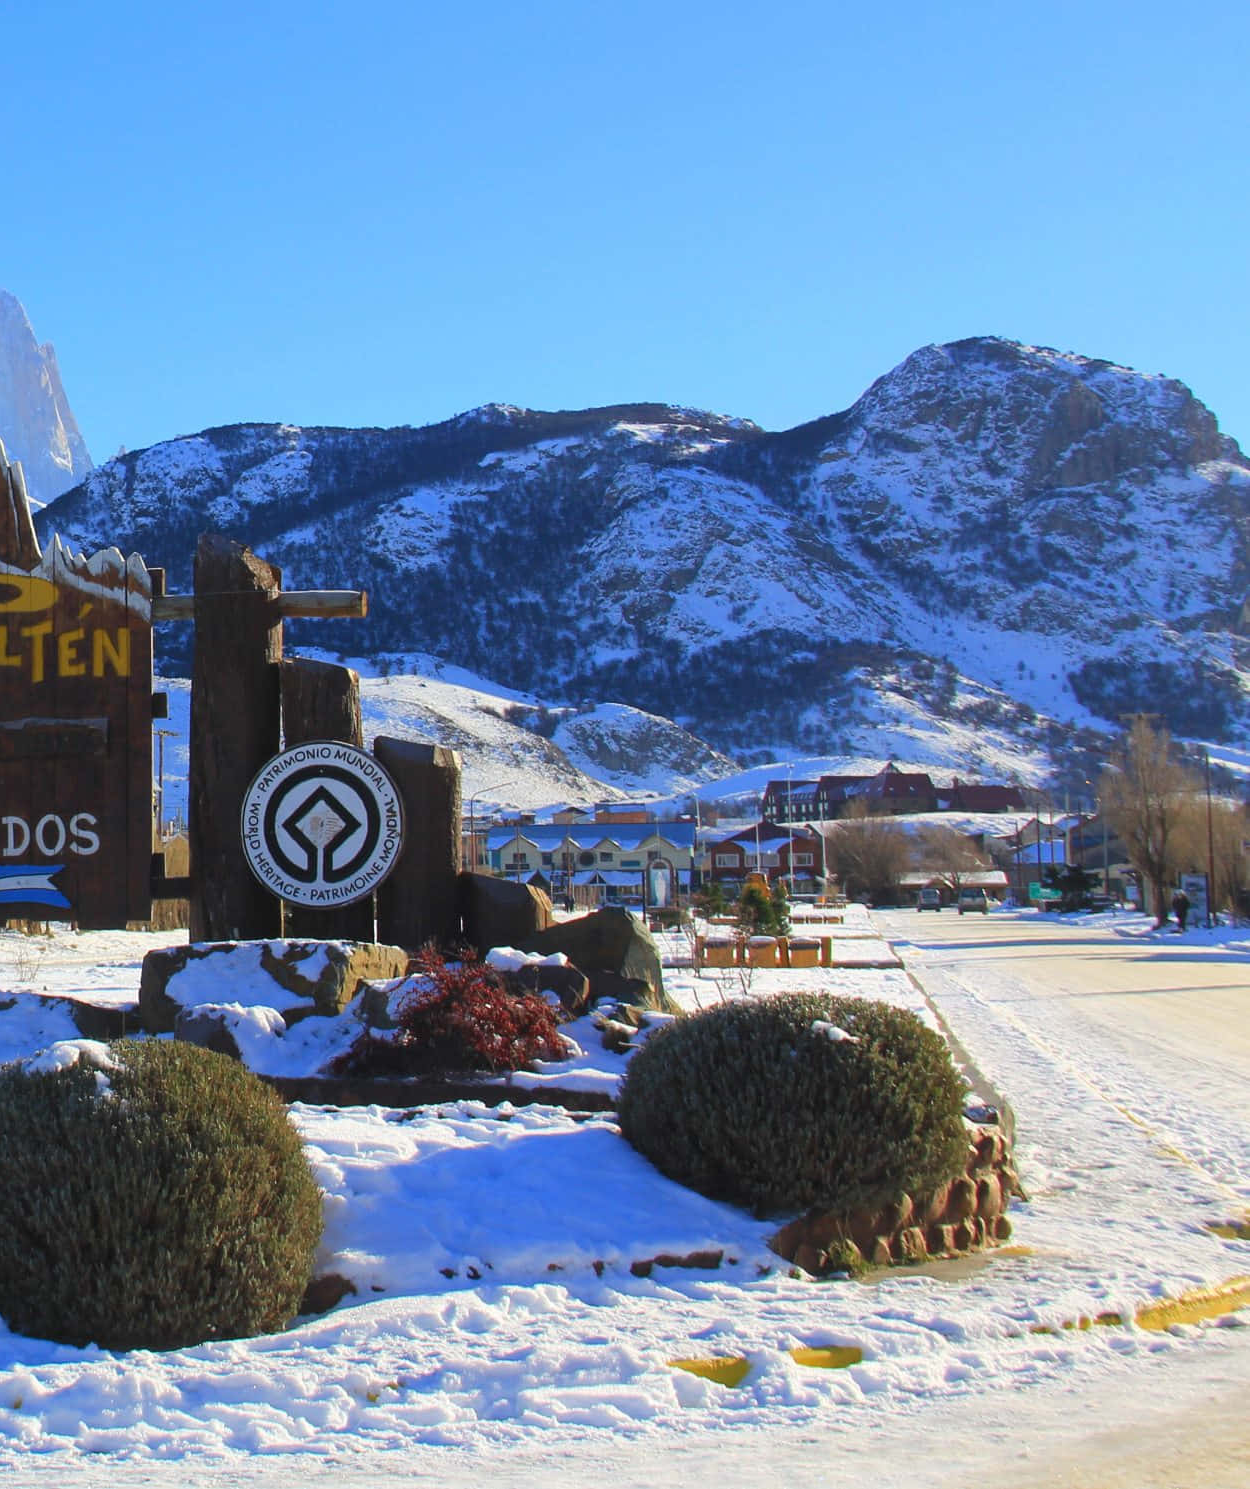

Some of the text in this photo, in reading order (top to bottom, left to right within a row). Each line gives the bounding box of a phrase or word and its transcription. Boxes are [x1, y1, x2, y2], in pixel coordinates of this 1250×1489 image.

[257, 747, 386, 793] PATRIMONIO MUNDIAL
[248, 803, 301, 898] WORLD HERITAGE
[310, 797, 398, 901] PATRIMOINE MONDIAL
